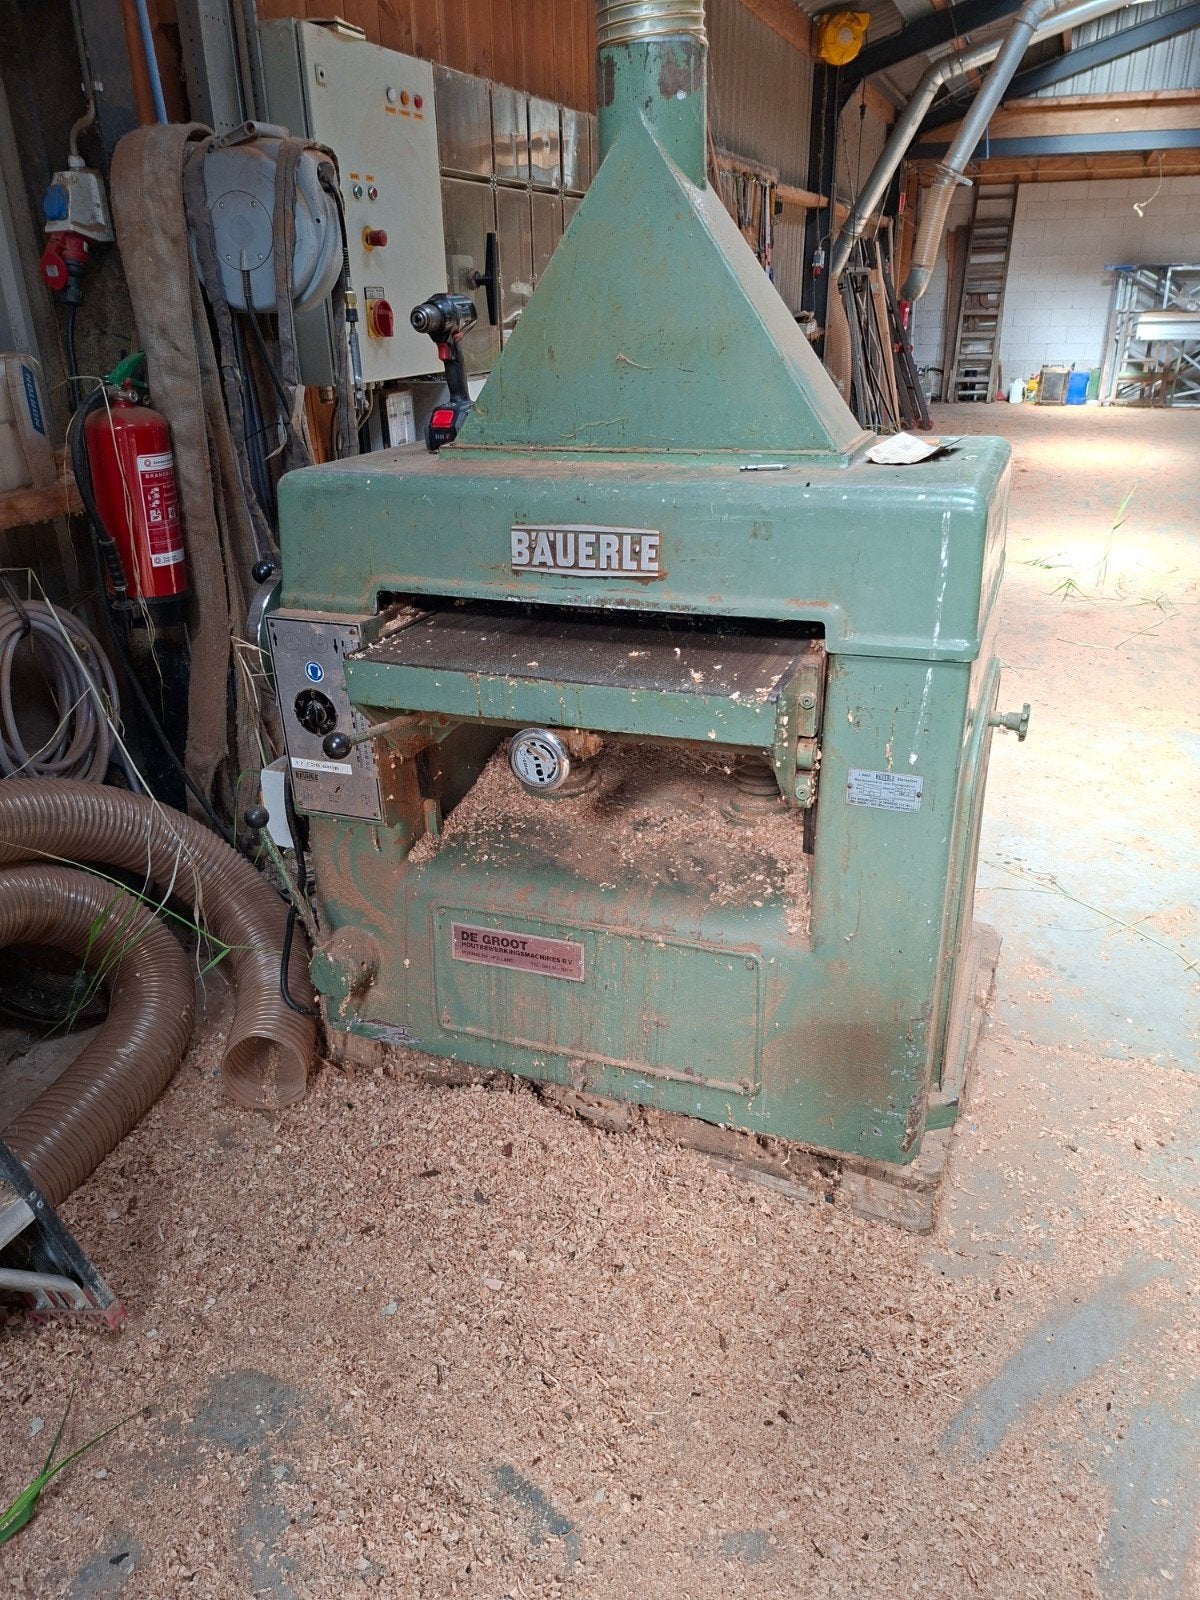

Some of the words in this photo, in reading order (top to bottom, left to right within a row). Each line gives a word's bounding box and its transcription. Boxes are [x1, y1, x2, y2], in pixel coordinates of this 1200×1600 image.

[25, 372, 41, 427] NORTON
[511, 530, 660, 571] BÄUERLE
[461, 931, 478, 942] DE
[482, 934, 528, 950] GROOT
[461, 941, 560, 963] HOUTBEWERKINGSMACHINES
